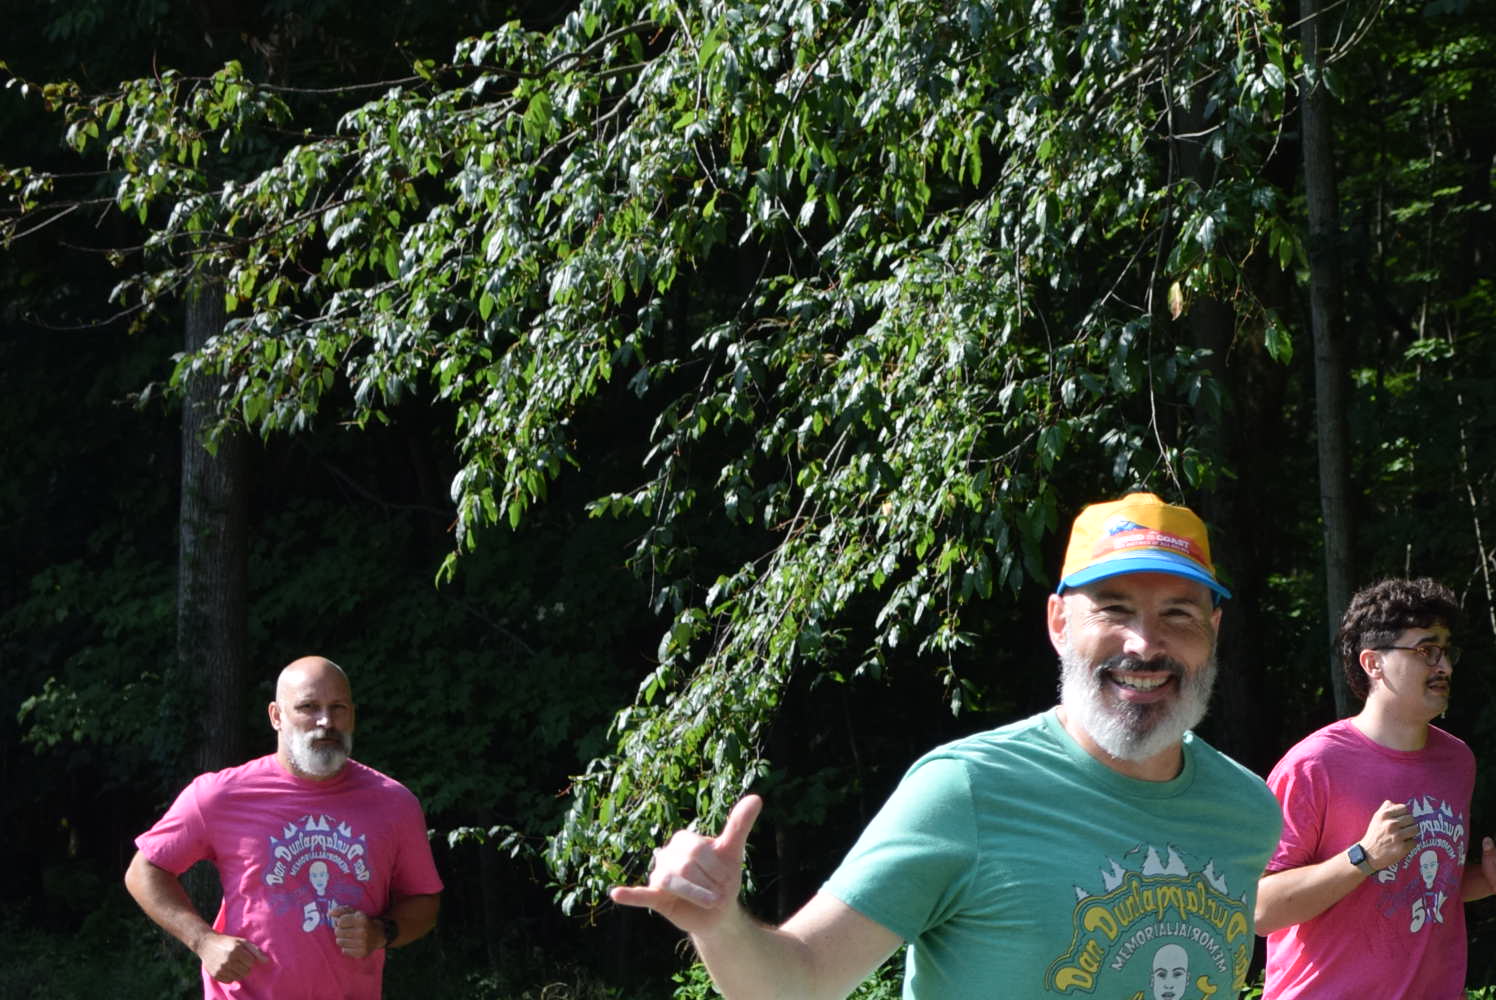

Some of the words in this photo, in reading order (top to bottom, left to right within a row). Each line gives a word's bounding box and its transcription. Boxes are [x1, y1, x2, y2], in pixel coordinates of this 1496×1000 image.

[1055, 940, 1105, 990] Dan
[1084, 880, 1169, 940] Dunlap
[1111, 922, 1174, 972] MEMORIAL
